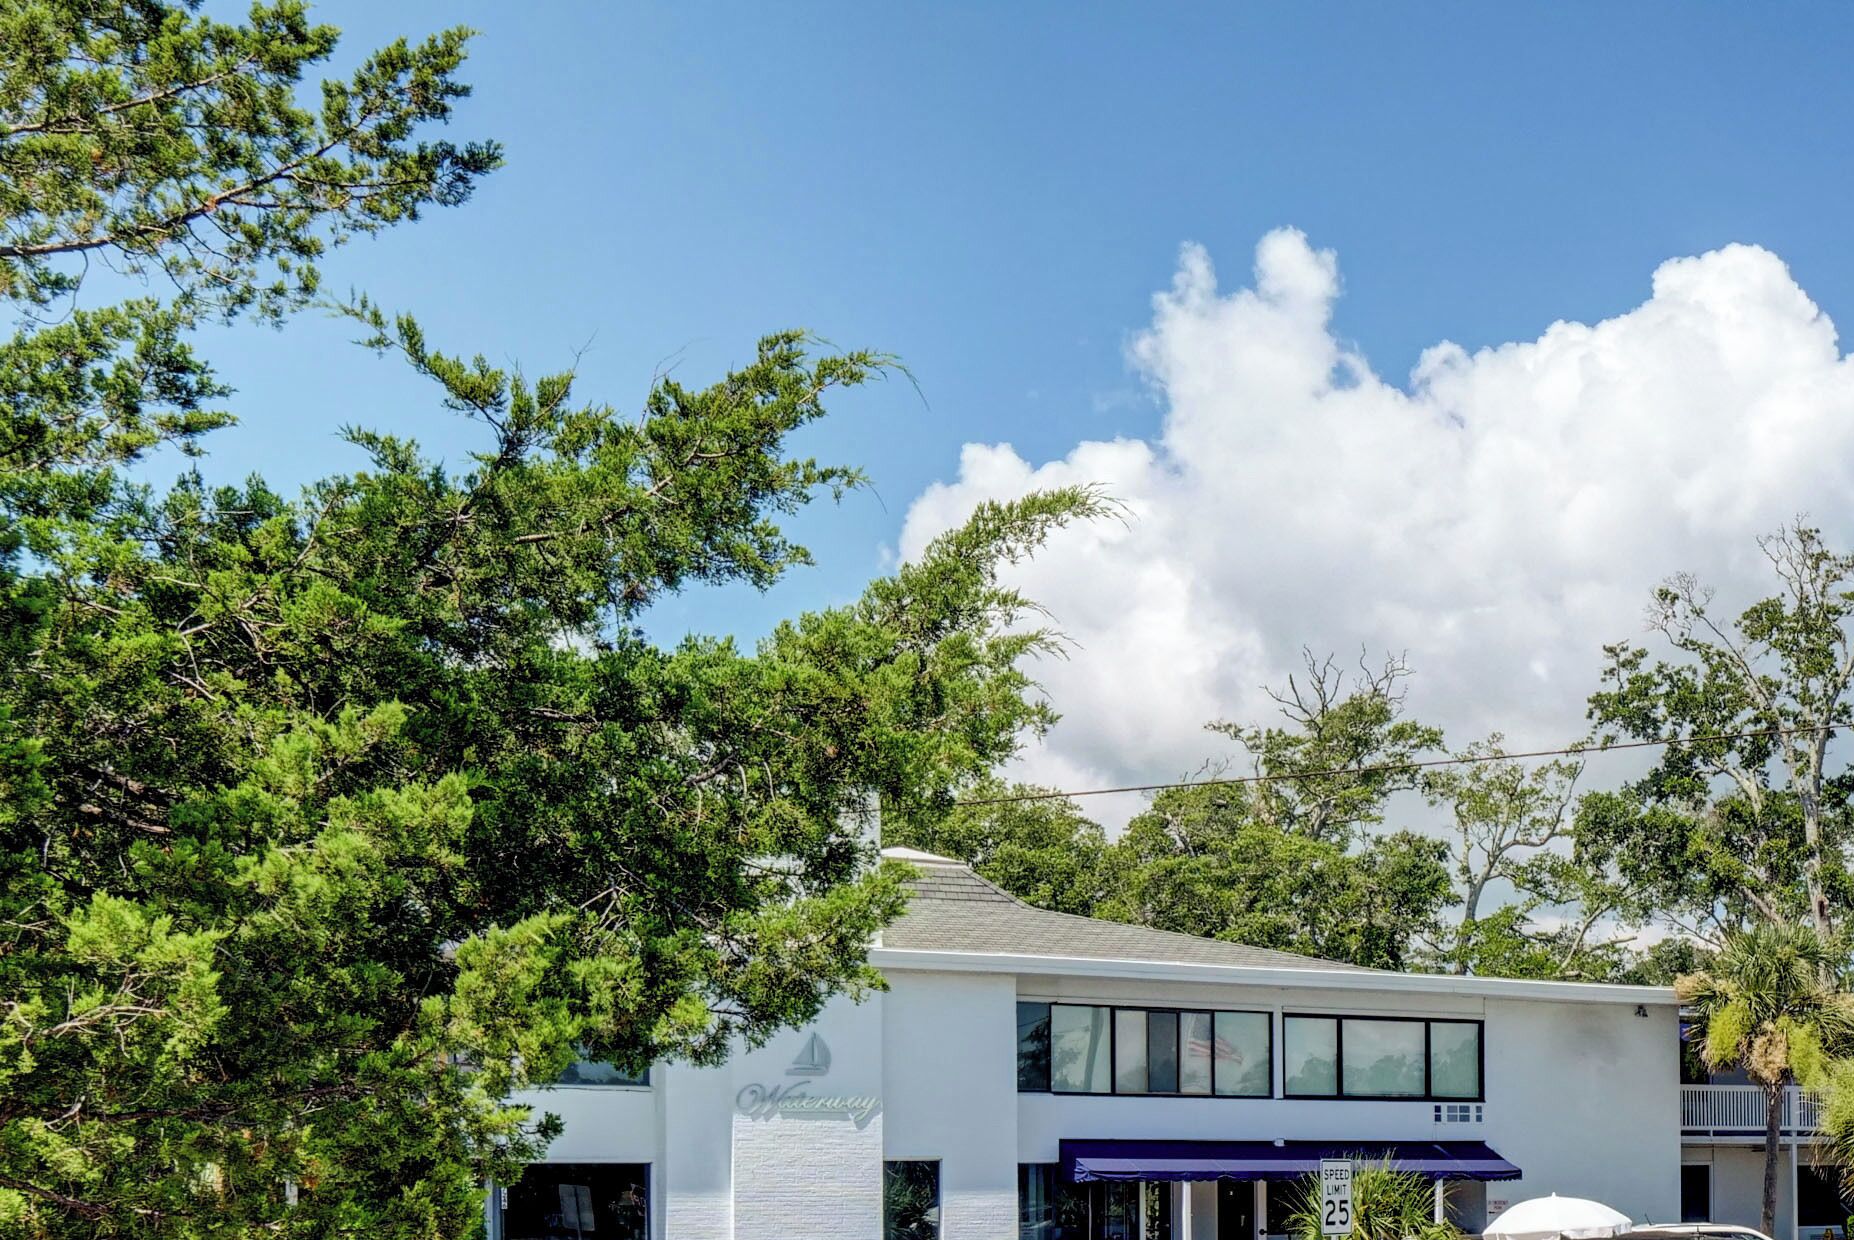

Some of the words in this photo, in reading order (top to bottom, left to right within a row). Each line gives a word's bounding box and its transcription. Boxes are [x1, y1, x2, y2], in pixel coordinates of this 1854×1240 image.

[735, 1080, 881, 1122] Waterway
[1324, 1169, 1350, 1180] SPEED
[1326, 1184, 1347, 1196] LIMIT
[1325, 1199, 1349, 1226] 25
